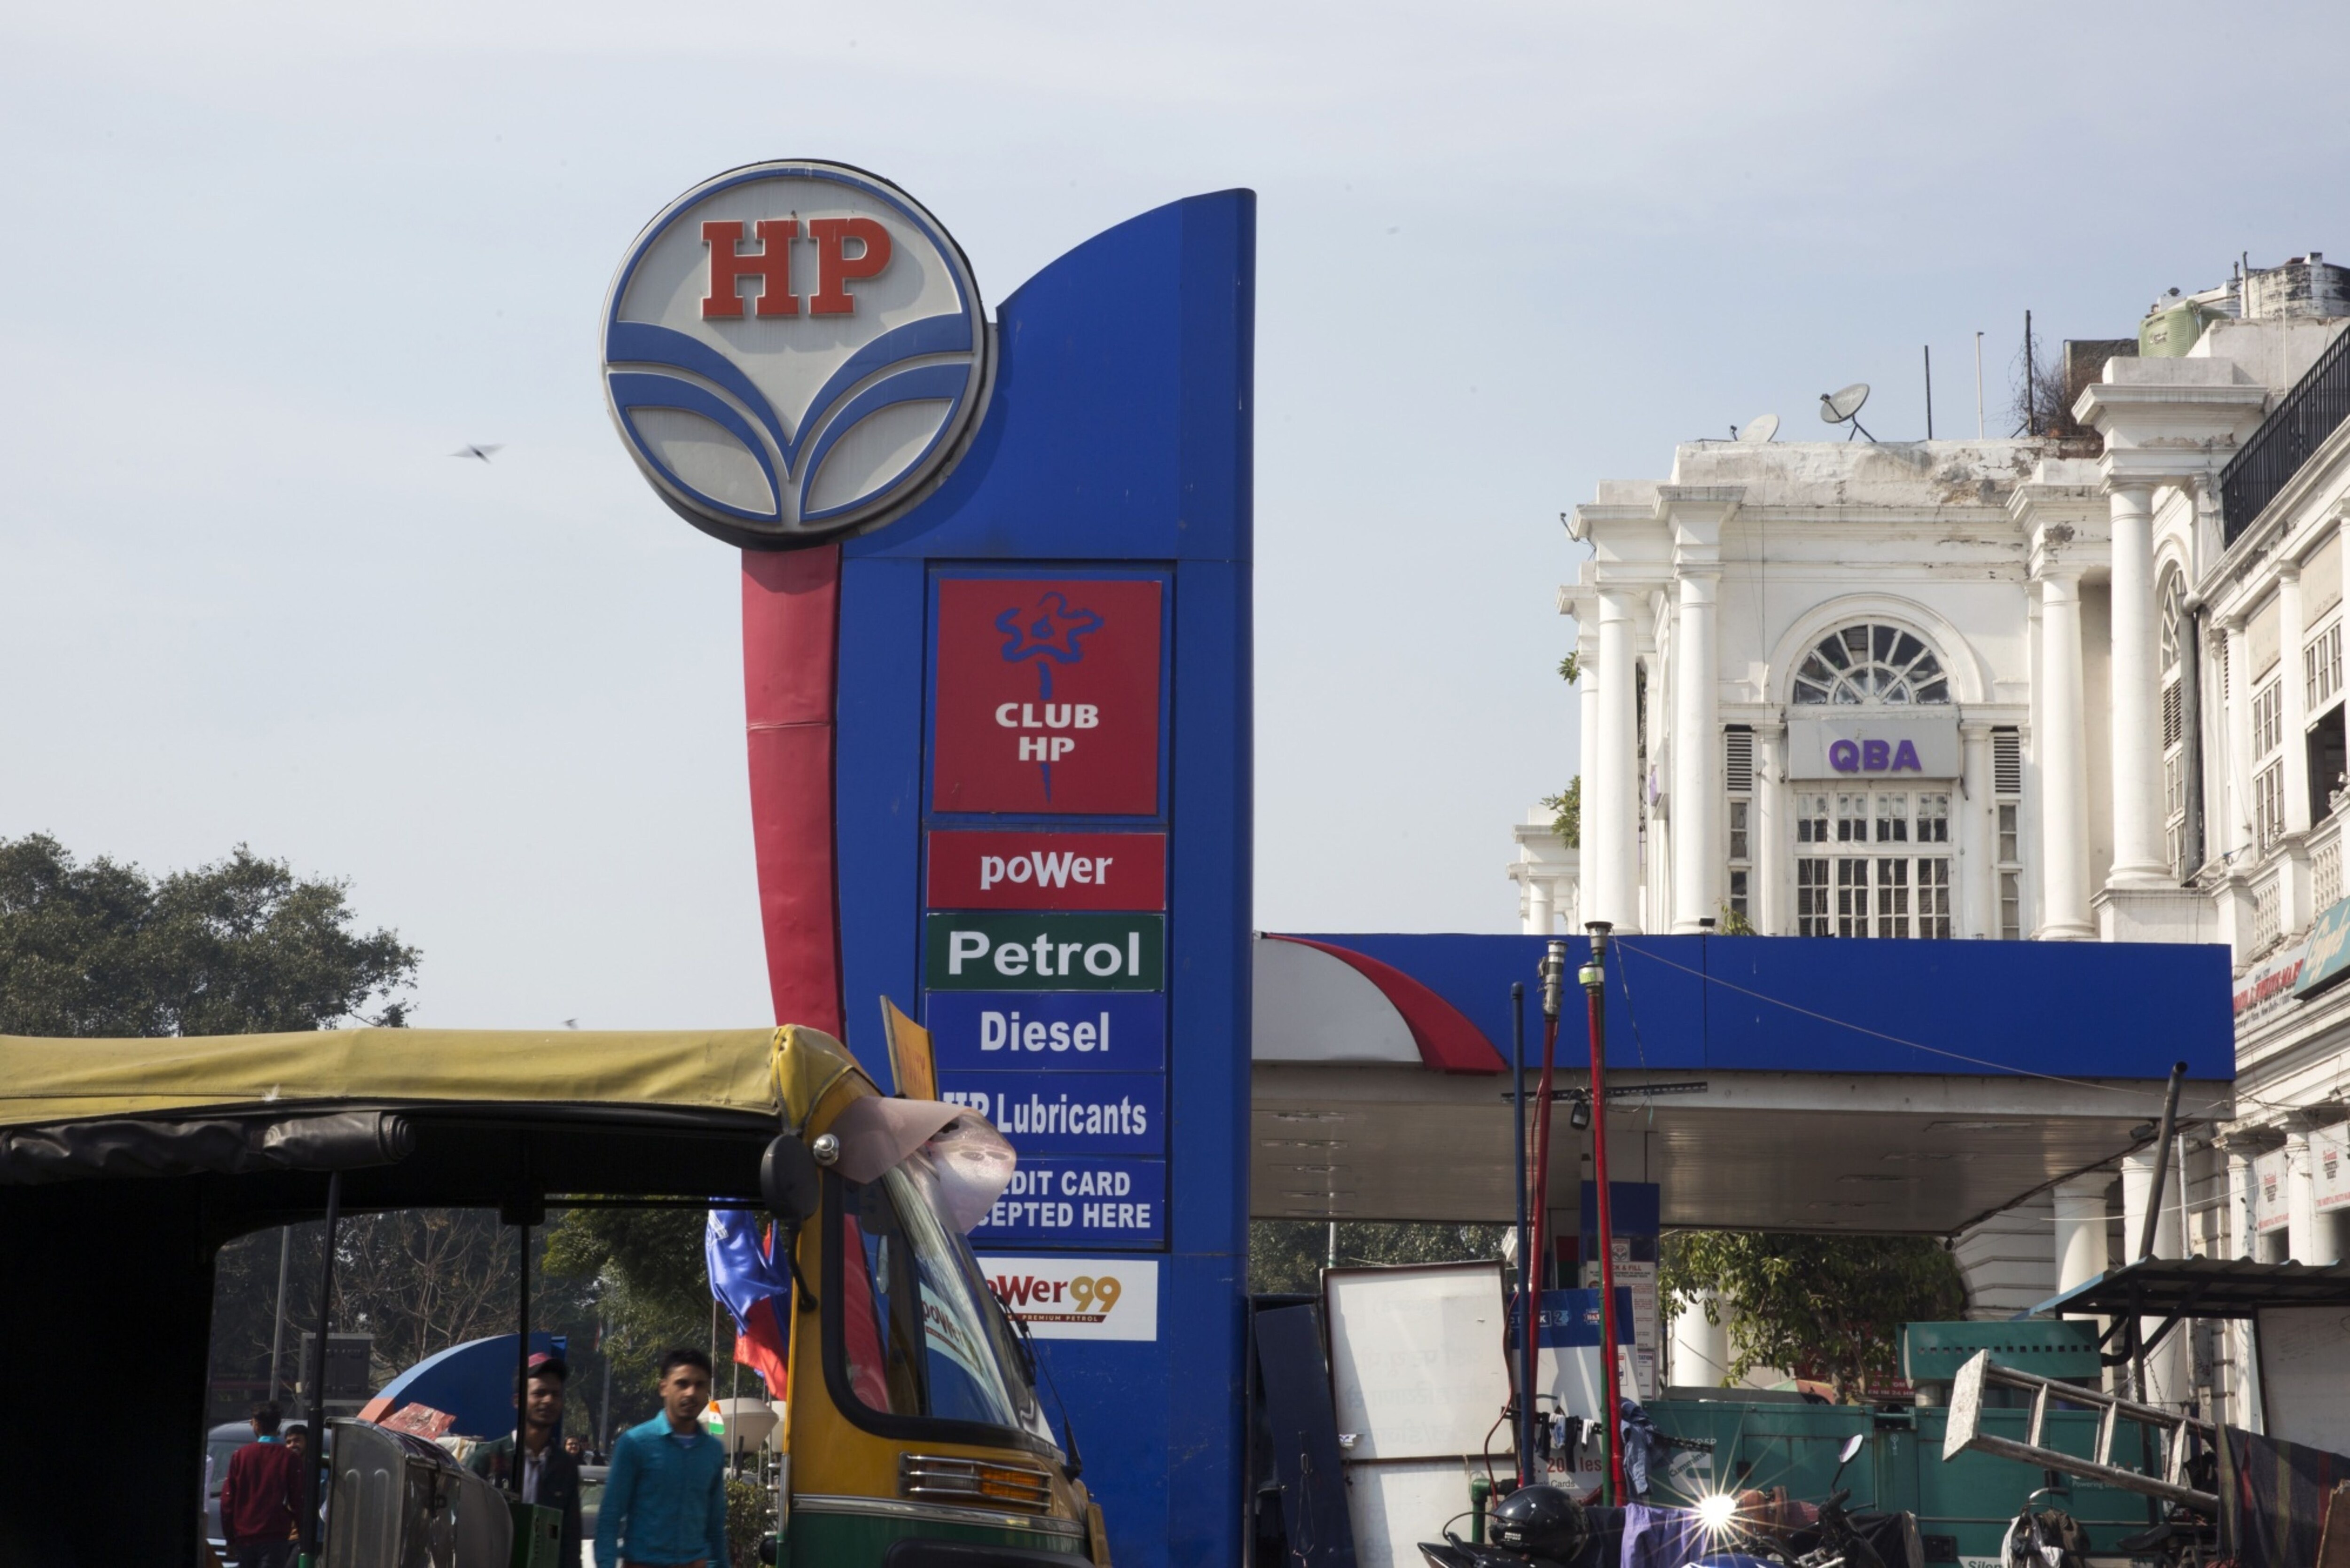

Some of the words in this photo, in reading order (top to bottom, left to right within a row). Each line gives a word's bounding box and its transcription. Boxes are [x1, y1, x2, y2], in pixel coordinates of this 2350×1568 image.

[701, 218, 892, 318] HP
[995, 703, 1099, 729] CLUB
[1018, 737, 1075, 761] HP
[1829, 739, 1922, 772] QBA
[948, 931, 1139, 976] Petrol
[981, 1011, 1109, 1051] Diesel
[997, 1093, 1147, 1135] Lubricants
[1001, 1170, 1053, 1196] DIT
[1061, 1171, 1130, 1196] CARD
[978, 1201, 1073, 1228] EPTED
[1082, 1203, 1151, 1228] HERE
[1547, 1458, 1565, 1473] 20
[1580, 1457, 1602, 1472] les
[2072, 1481, 2103, 1490] Powering
